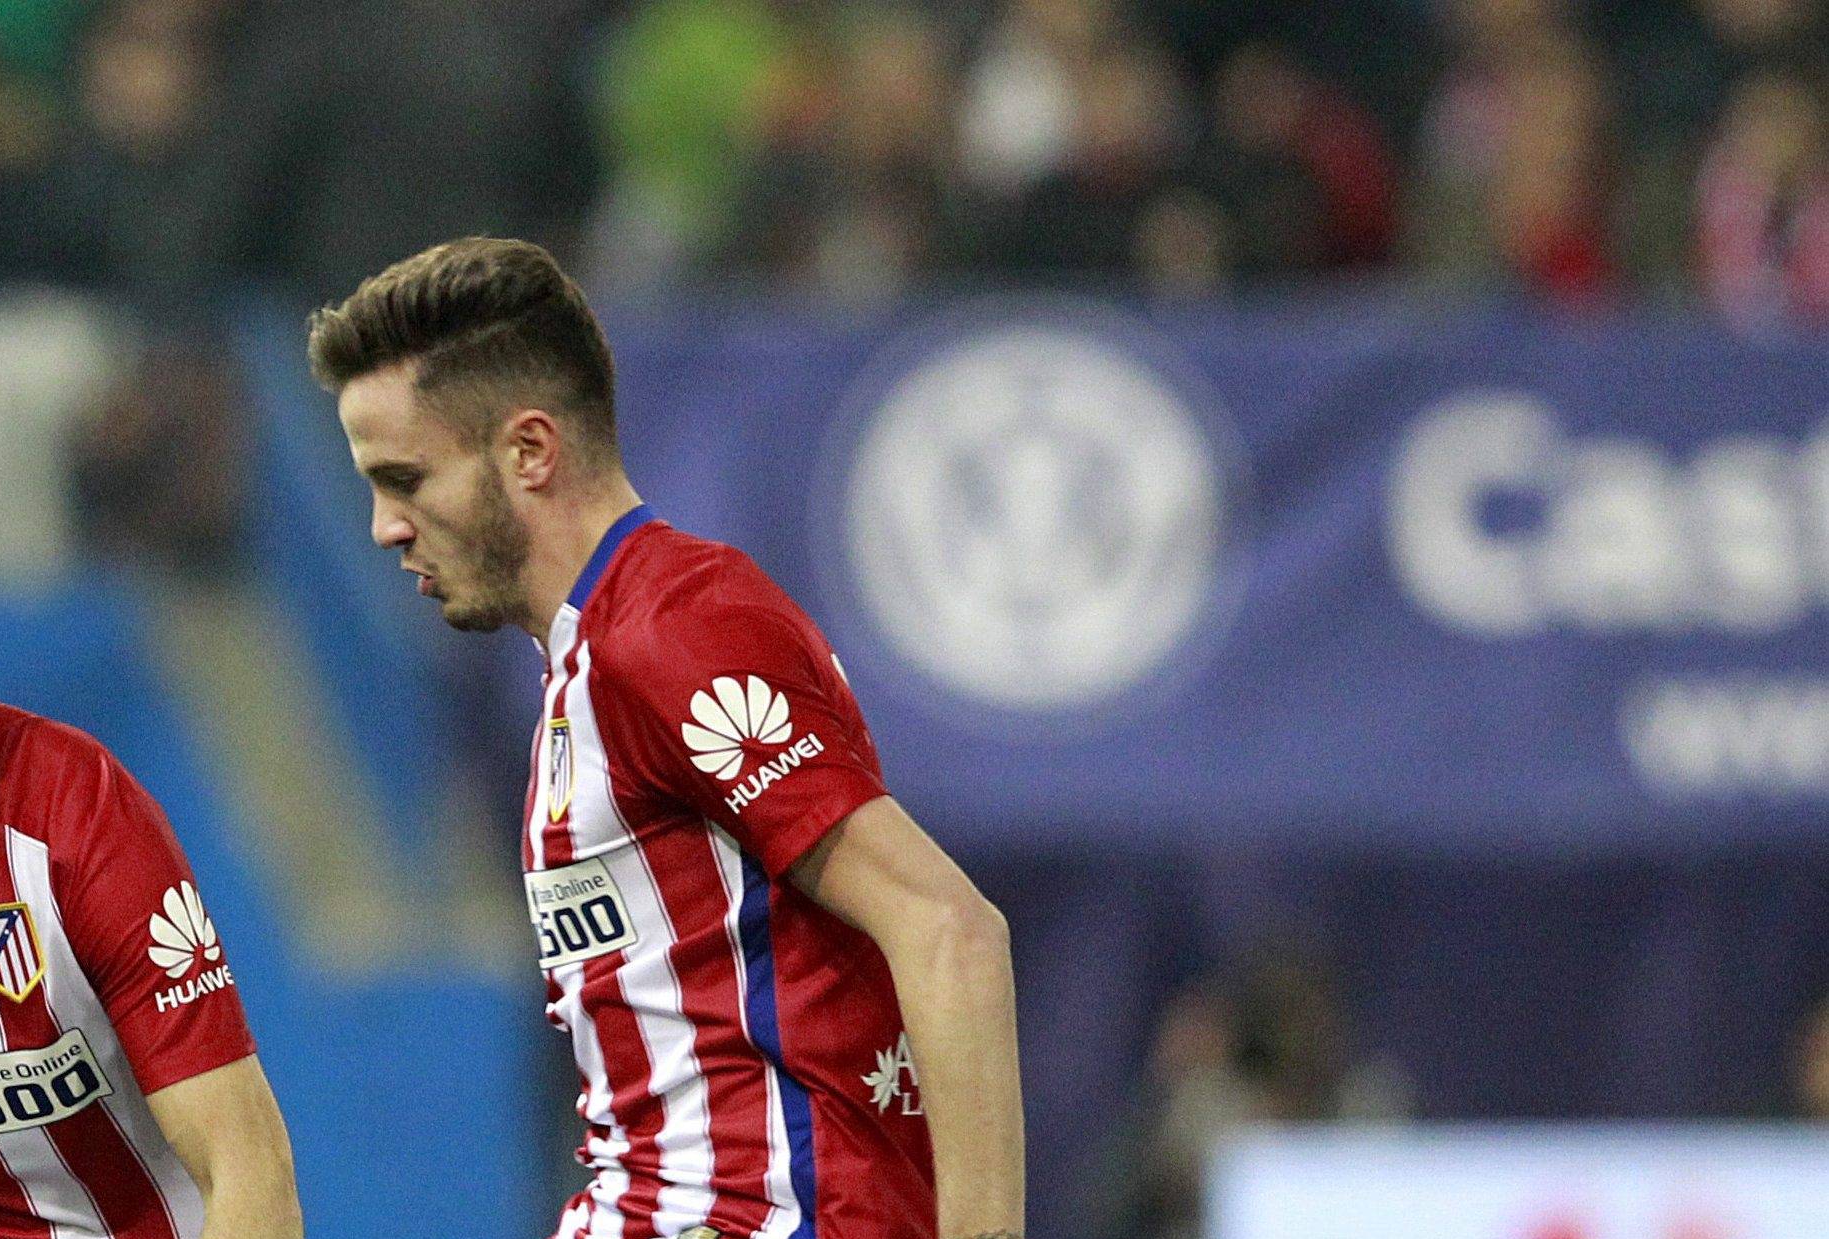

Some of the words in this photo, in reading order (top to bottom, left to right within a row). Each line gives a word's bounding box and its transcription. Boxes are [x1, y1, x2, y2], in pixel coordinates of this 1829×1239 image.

[724, 732, 825, 815] HUAWEI
[154, 964, 235, 1013] HUAWE
[15, 1043, 82, 1079] Online
